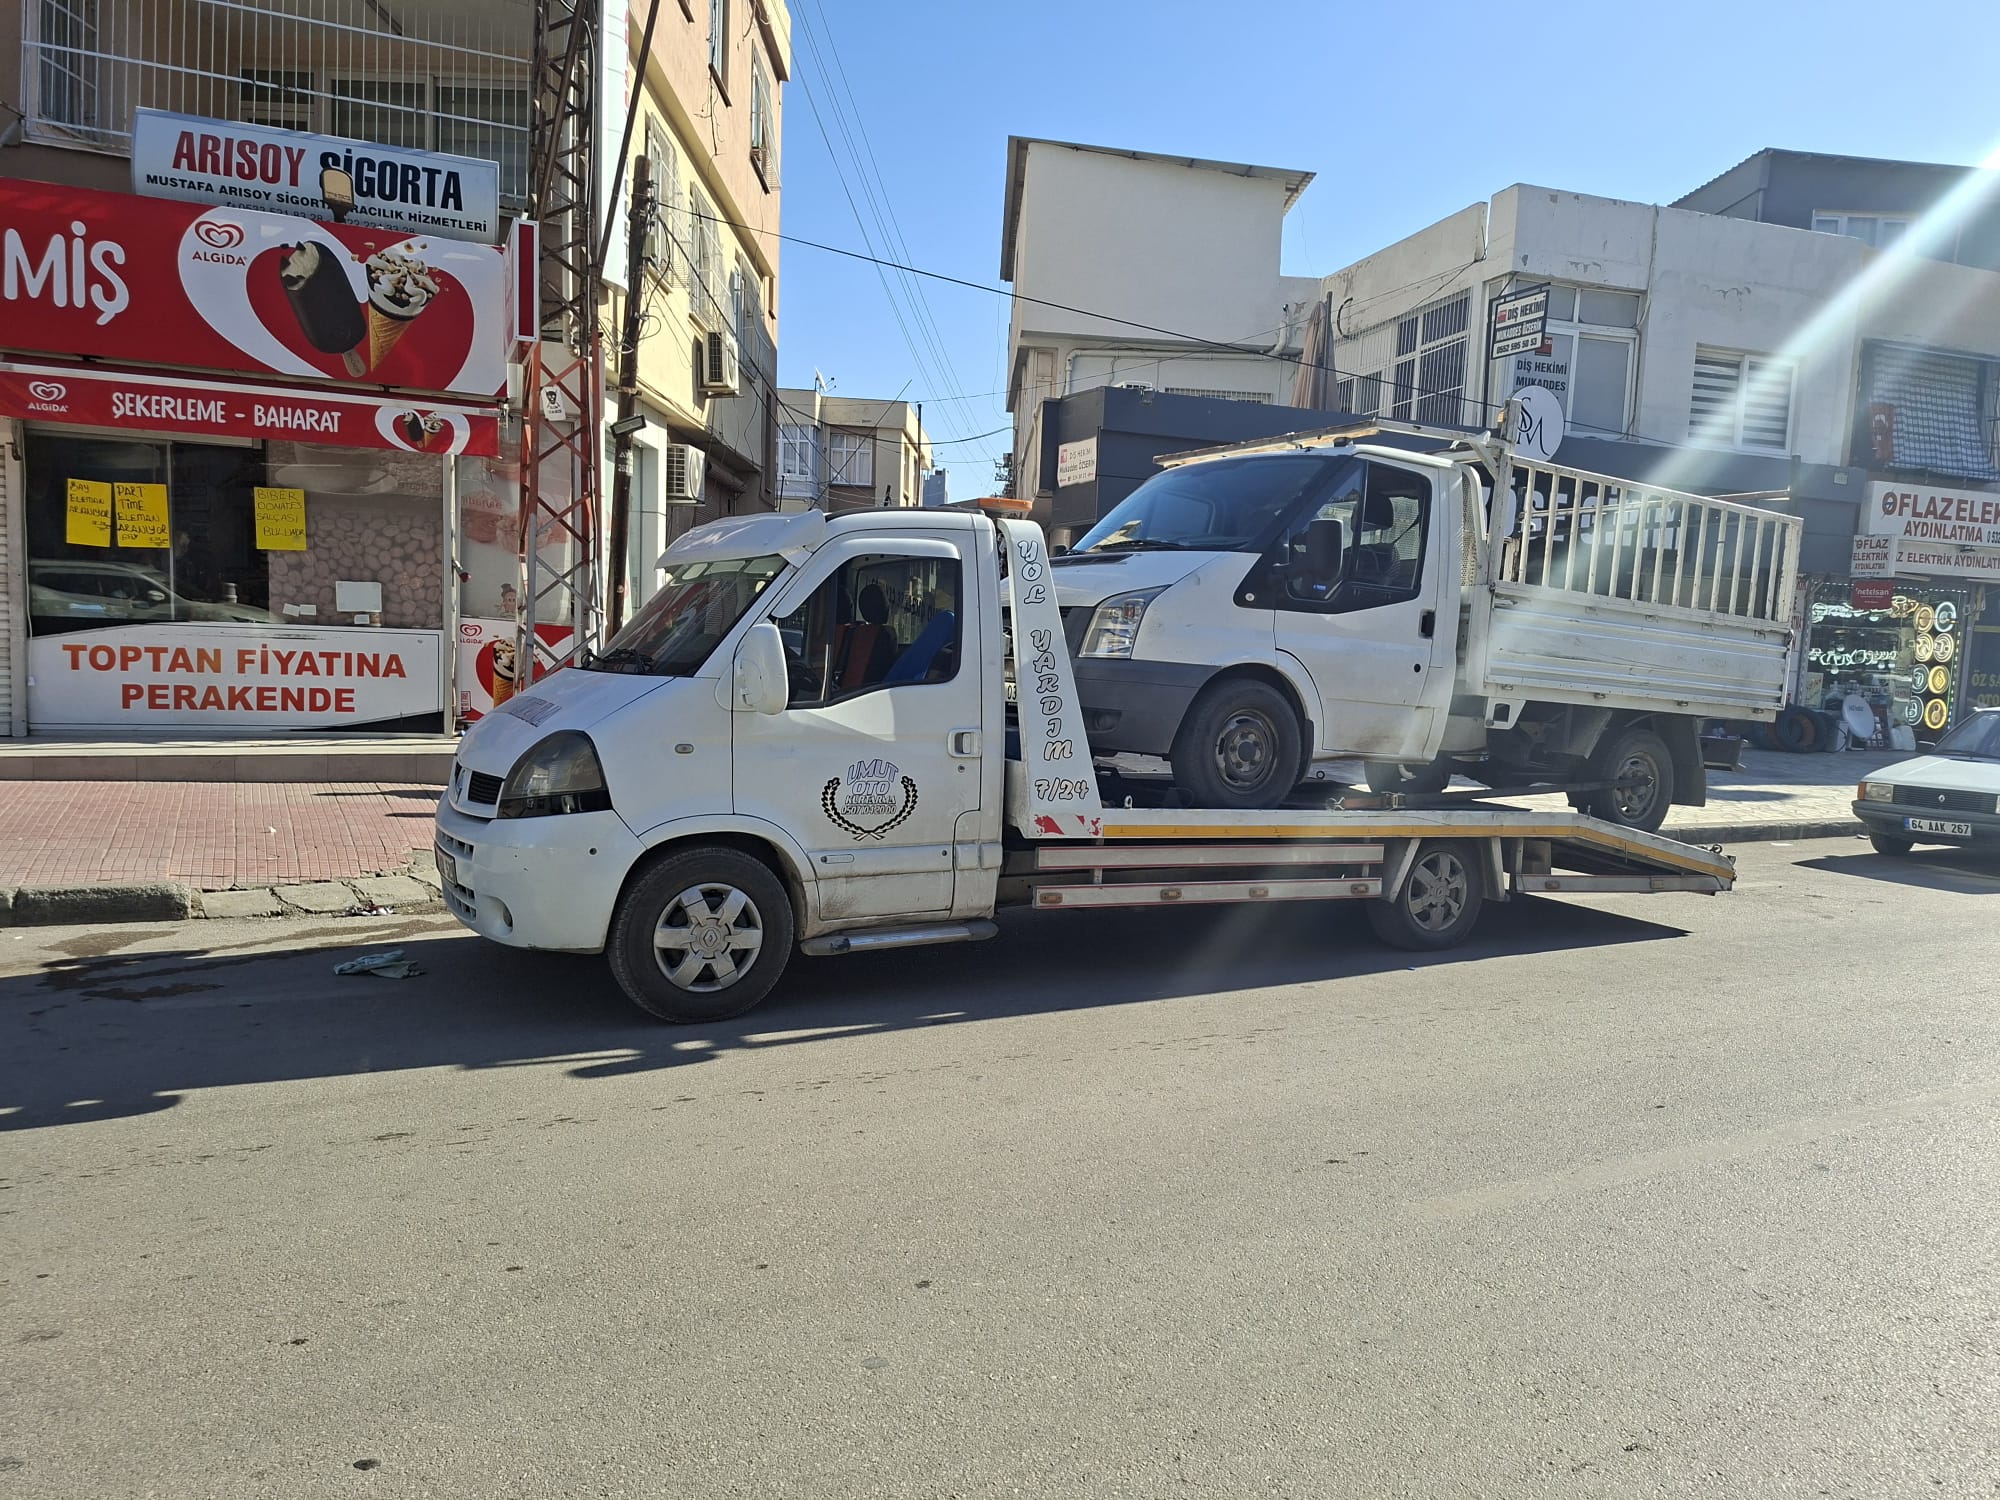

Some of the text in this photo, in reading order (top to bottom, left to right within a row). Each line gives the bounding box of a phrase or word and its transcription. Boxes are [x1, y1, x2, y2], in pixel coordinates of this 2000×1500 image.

[172, 131, 307, 187] ARISOY
[146, 174, 214, 192] MUSTAFA
[219, 185, 272, 200] ARISOY
[276, 191, 331, 210] SİGORT
[350, 204, 403, 221] RACILIK
[408, 210, 487, 232] HİZMETLERİ
[1517, 358, 1567, 375] DİŞ HEKİMİ
[112, 392, 226, 423] ŞEKERLEME
[254, 404, 341, 433] BAHARAT
[117, 486, 145, 497] PART
[1903, 520, 1983, 542] AYDINLATMA
[1018, 540, 1046, 605] YOL
[1907, 552, 1952, 566] ELEKTRİK
[1954, 556, 2000, 570] AYDINLAT
[62, 643, 407, 678] TOPTAN FİYATINA
[121, 683, 355, 713] PERAKENDE
[1030, 629, 1073, 761] YARDIM
[847, 759, 899, 785] UMUT
[852, 781, 890, 795] OTO
[1035, 778, 1089, 801] 7/24
[1911, 819, 1970, 835] 64 AAK 267
